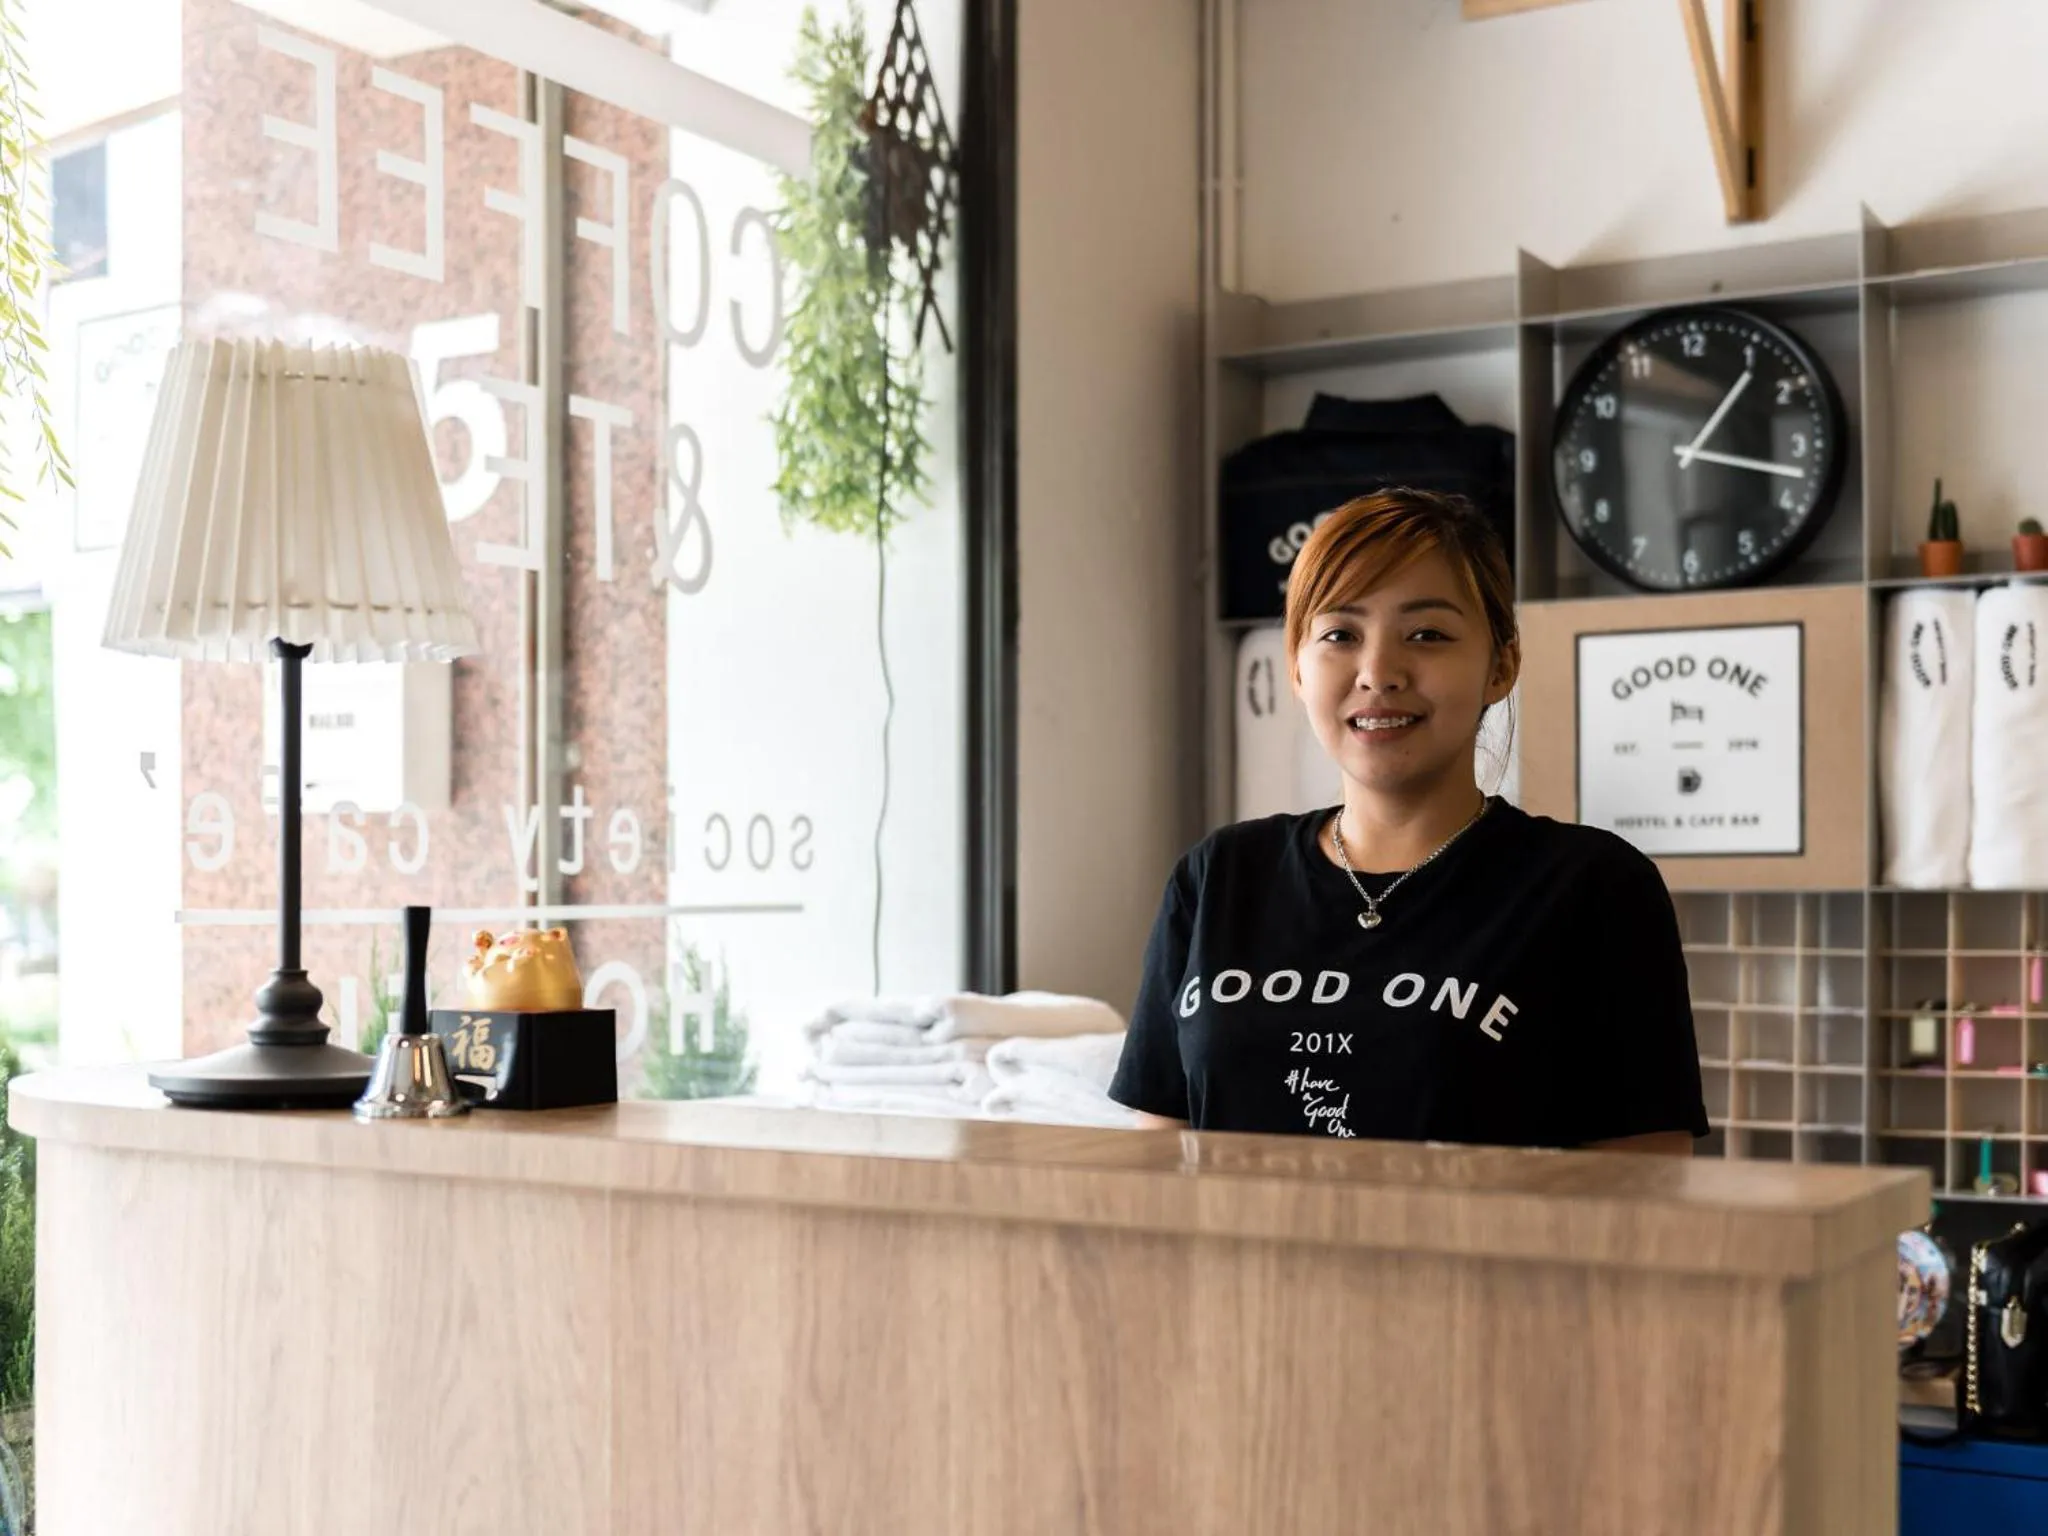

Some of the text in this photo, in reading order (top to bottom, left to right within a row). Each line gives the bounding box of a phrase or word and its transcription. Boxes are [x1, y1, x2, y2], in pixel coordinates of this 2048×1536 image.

[1681, 333, 1706, 357] 12
[1630, 355, 1651, 379] 11
[1743, 345, 1755, 370] 1
[1775, 380, 1791, 405] 2
[1595, 395, 1616, 419] 10
[1791, 433, 1807, 458] 3
[1580, 450, 1596, 473] 9
[1595, 499, 1610, 523] 8
[1778, 488, 1795, 511] 4
[1632, 536, 1647, 560] 7
[1738, 530, 1754, 555] 5
[1683, 550, 1699, 574] 6
[1611, 654, 1769, 700] GOOD ONE
[1179, 969, 1519, 1042] GOOD ONE
[452, 1015, 497, 1071] 福
[1289, 1032, 1354, 1055] 201X
